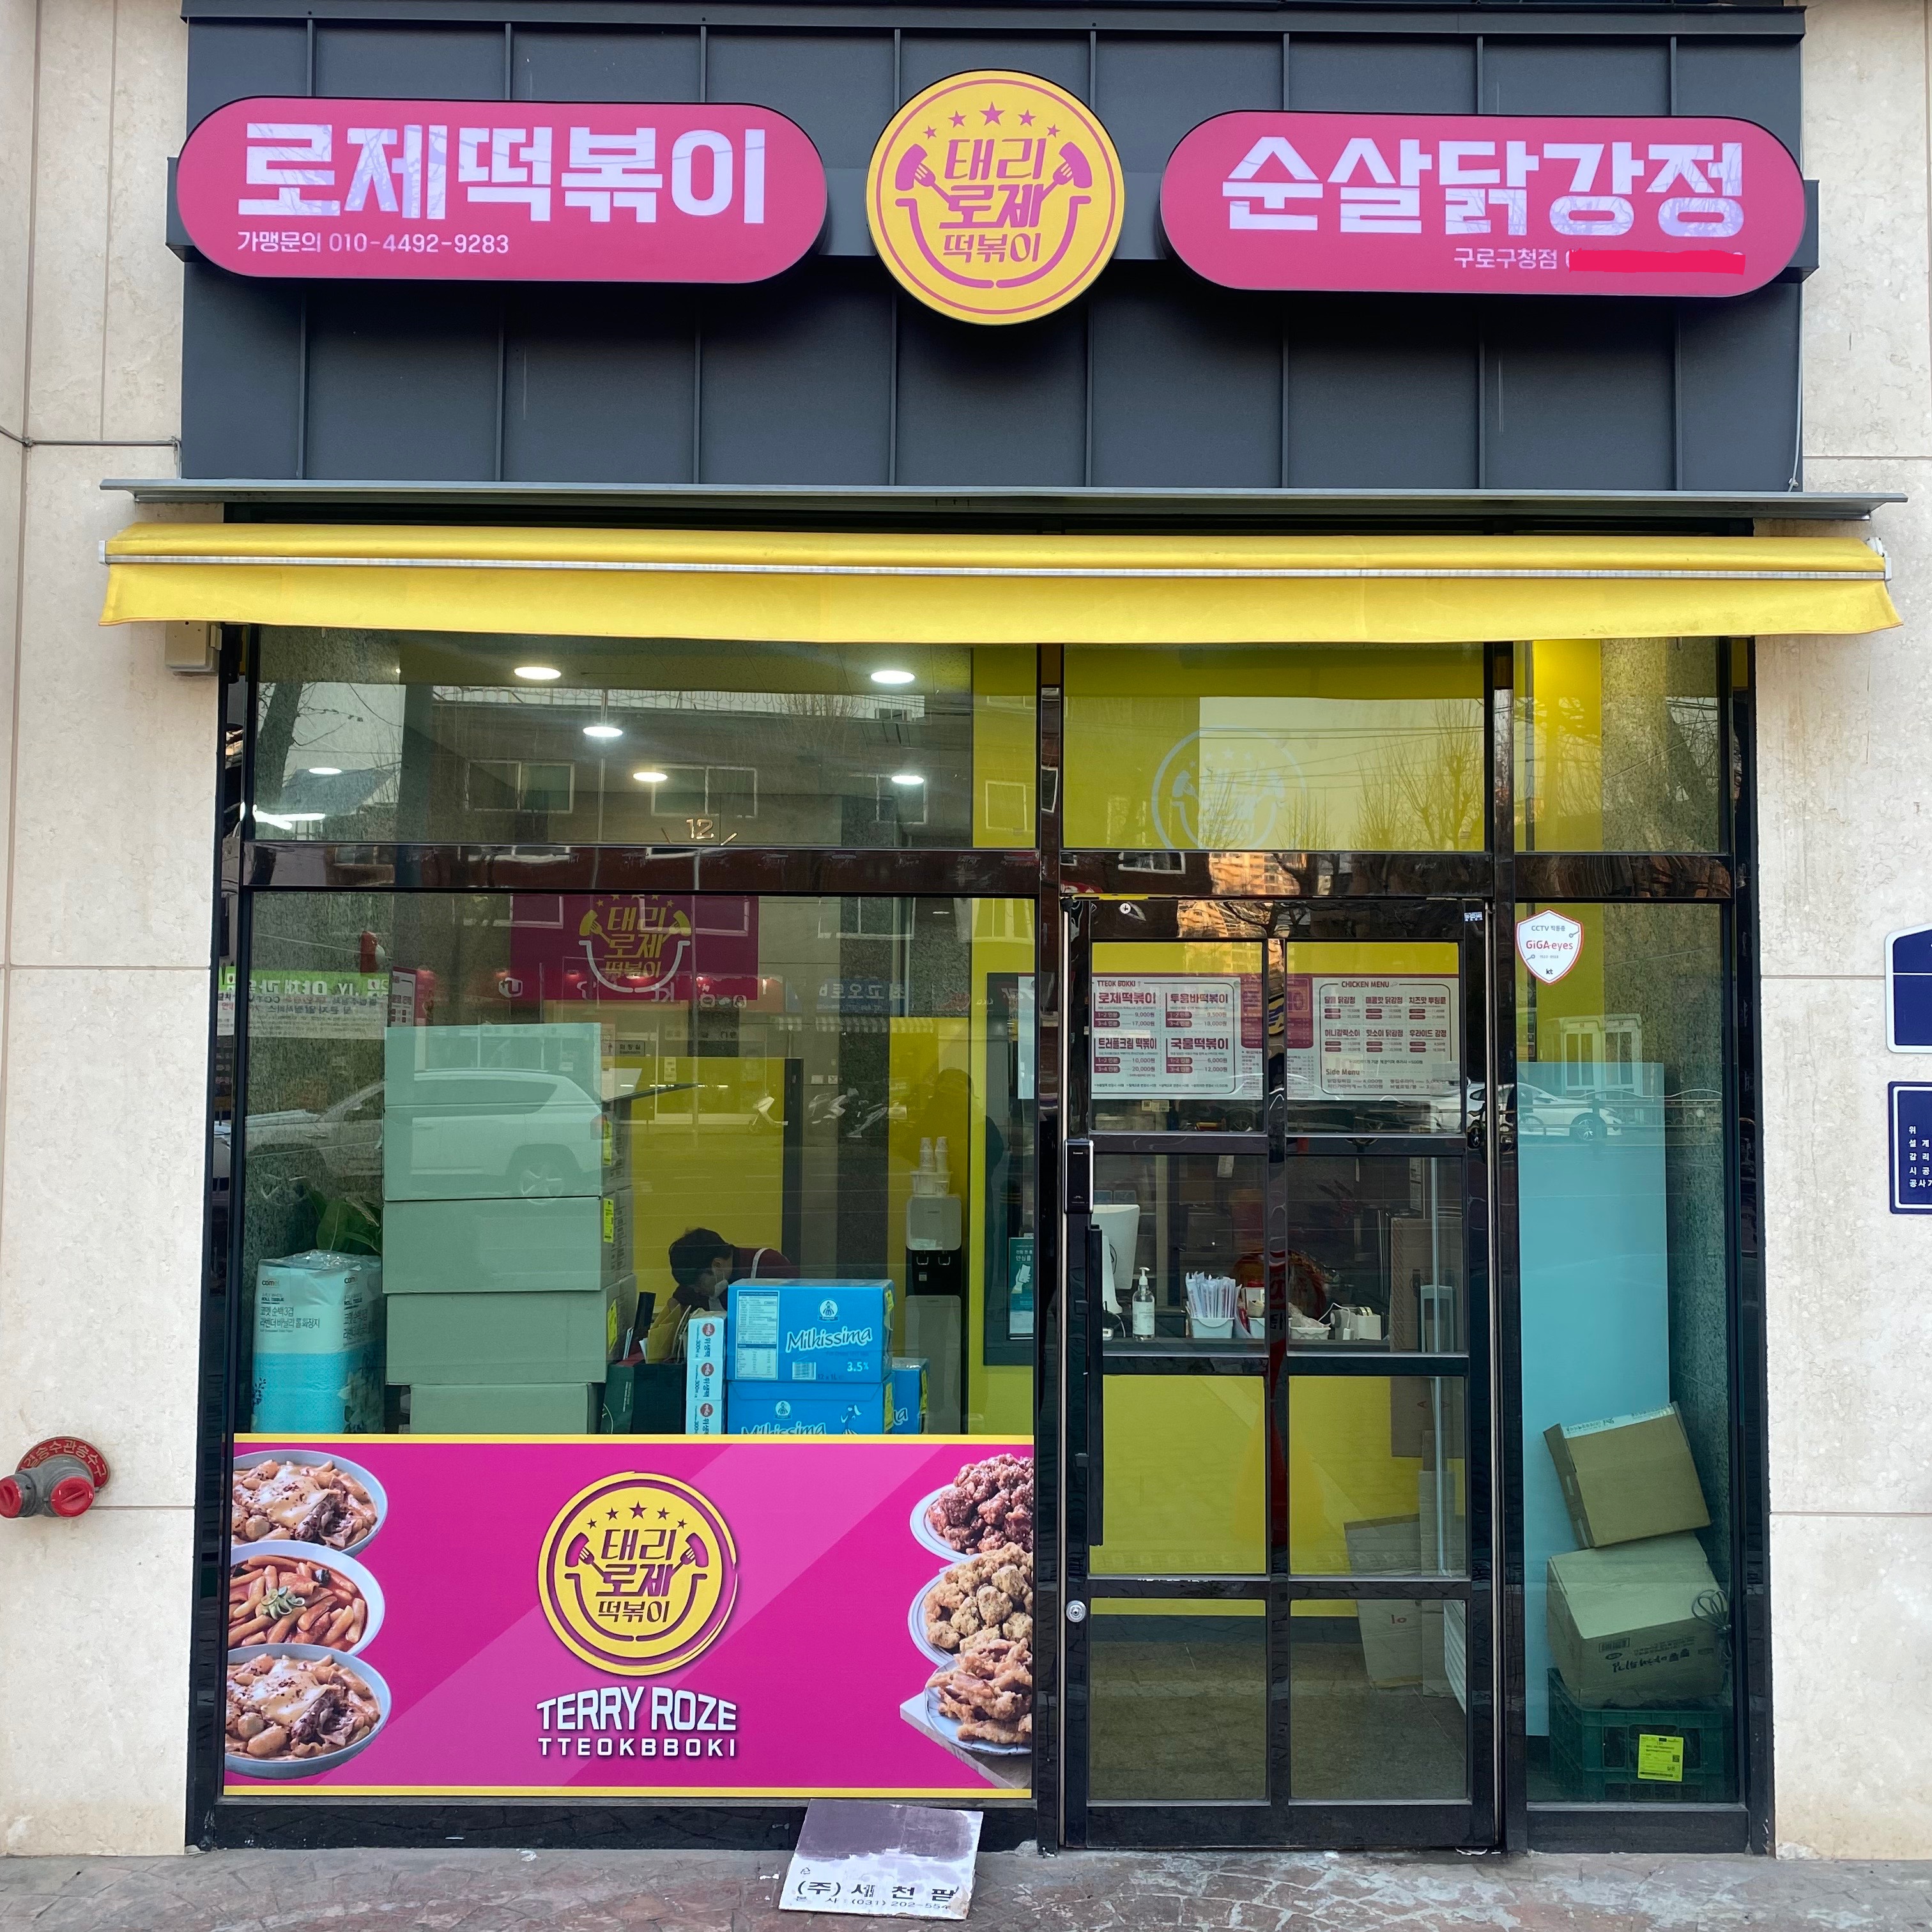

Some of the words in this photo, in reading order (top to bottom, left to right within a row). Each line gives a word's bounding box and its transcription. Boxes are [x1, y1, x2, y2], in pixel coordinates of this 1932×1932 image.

[944, 137, 1047, 180] 태리
[238, 123, 766, 224] 로제떡볶이
[1222, 136, 1745, 238] 순살닭강정
[939, 183, 1045, 229] 로제
[237, 231, 321, 253] 가맹문의
[328, 233, 510, 254] 010-4492-9283
[943, 233, 1041, 263] 떡볶이
[1453, 247, 1558, 270] 구로구청점
[606, 906, 668, 932] 태리
[1526, 940, 1550, 949] GiGA
[1551, 942, 1573, 951] eyes
[1098, 992, 1156, 1004] 로제떡볶이
[1170, 993, 1229, 1004] 투움바떡볶이
[1385, 996, 1403, 1004] 닭강정
[1098, 1038, 1134, 1049] 트러플크림
[1135, 1038, 1157, 1049] 떡볶이
[1170, 1038, 1229, 1050] 국물떡볶이
[1908, 1126, 1917, 1135] 위
[785, 1326, 873, 1353] Milkissima
[847, 1361, 870, 1372] 3.5%
[21, 1439, 108, 1478] 결송수관송수구
[601, 1528, 677, 1561] 태리
[595, 1563, 675, 1597] 로제
[597, 1600, 670, 1623] 떡볶이
[537, 1685, 645, 1731] TERRY
[651, 1685, 737, 1731] ROZE
[537, 1737, 735, 1758] TTEOKBBOKI
[797, 1880, 841, 1897] (주)
